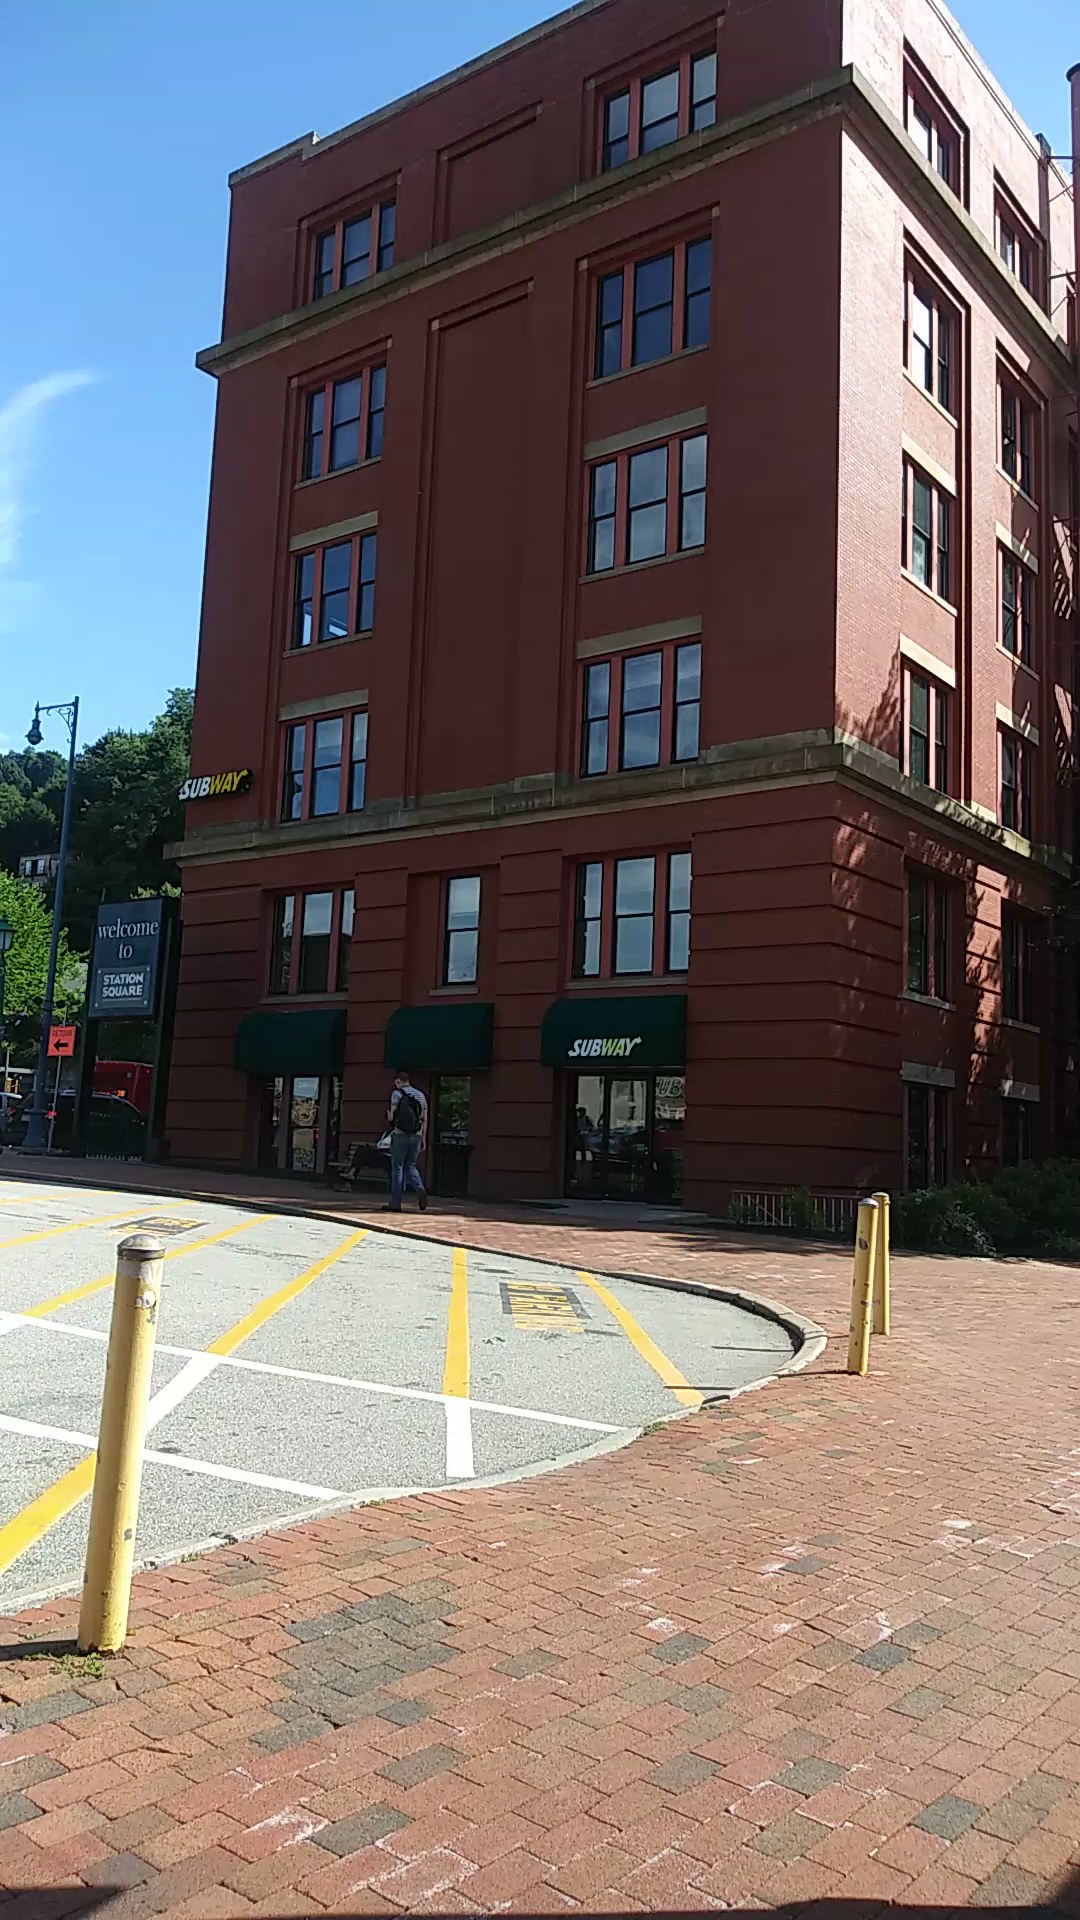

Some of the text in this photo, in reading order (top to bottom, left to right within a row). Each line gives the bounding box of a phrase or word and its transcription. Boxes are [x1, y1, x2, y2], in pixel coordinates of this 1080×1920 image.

[178, 769, 248, 800] SUBWAY
[98, 918, 159, 938] welcome
[118, 942, 133, 959] to
[103, 973, 144, 985] STATION
[102, 985, 143, 997] SQUARE
[52, 1029, 73, 1037] DETOUR
[568, 1036, 642, 1057] SUBWAY
